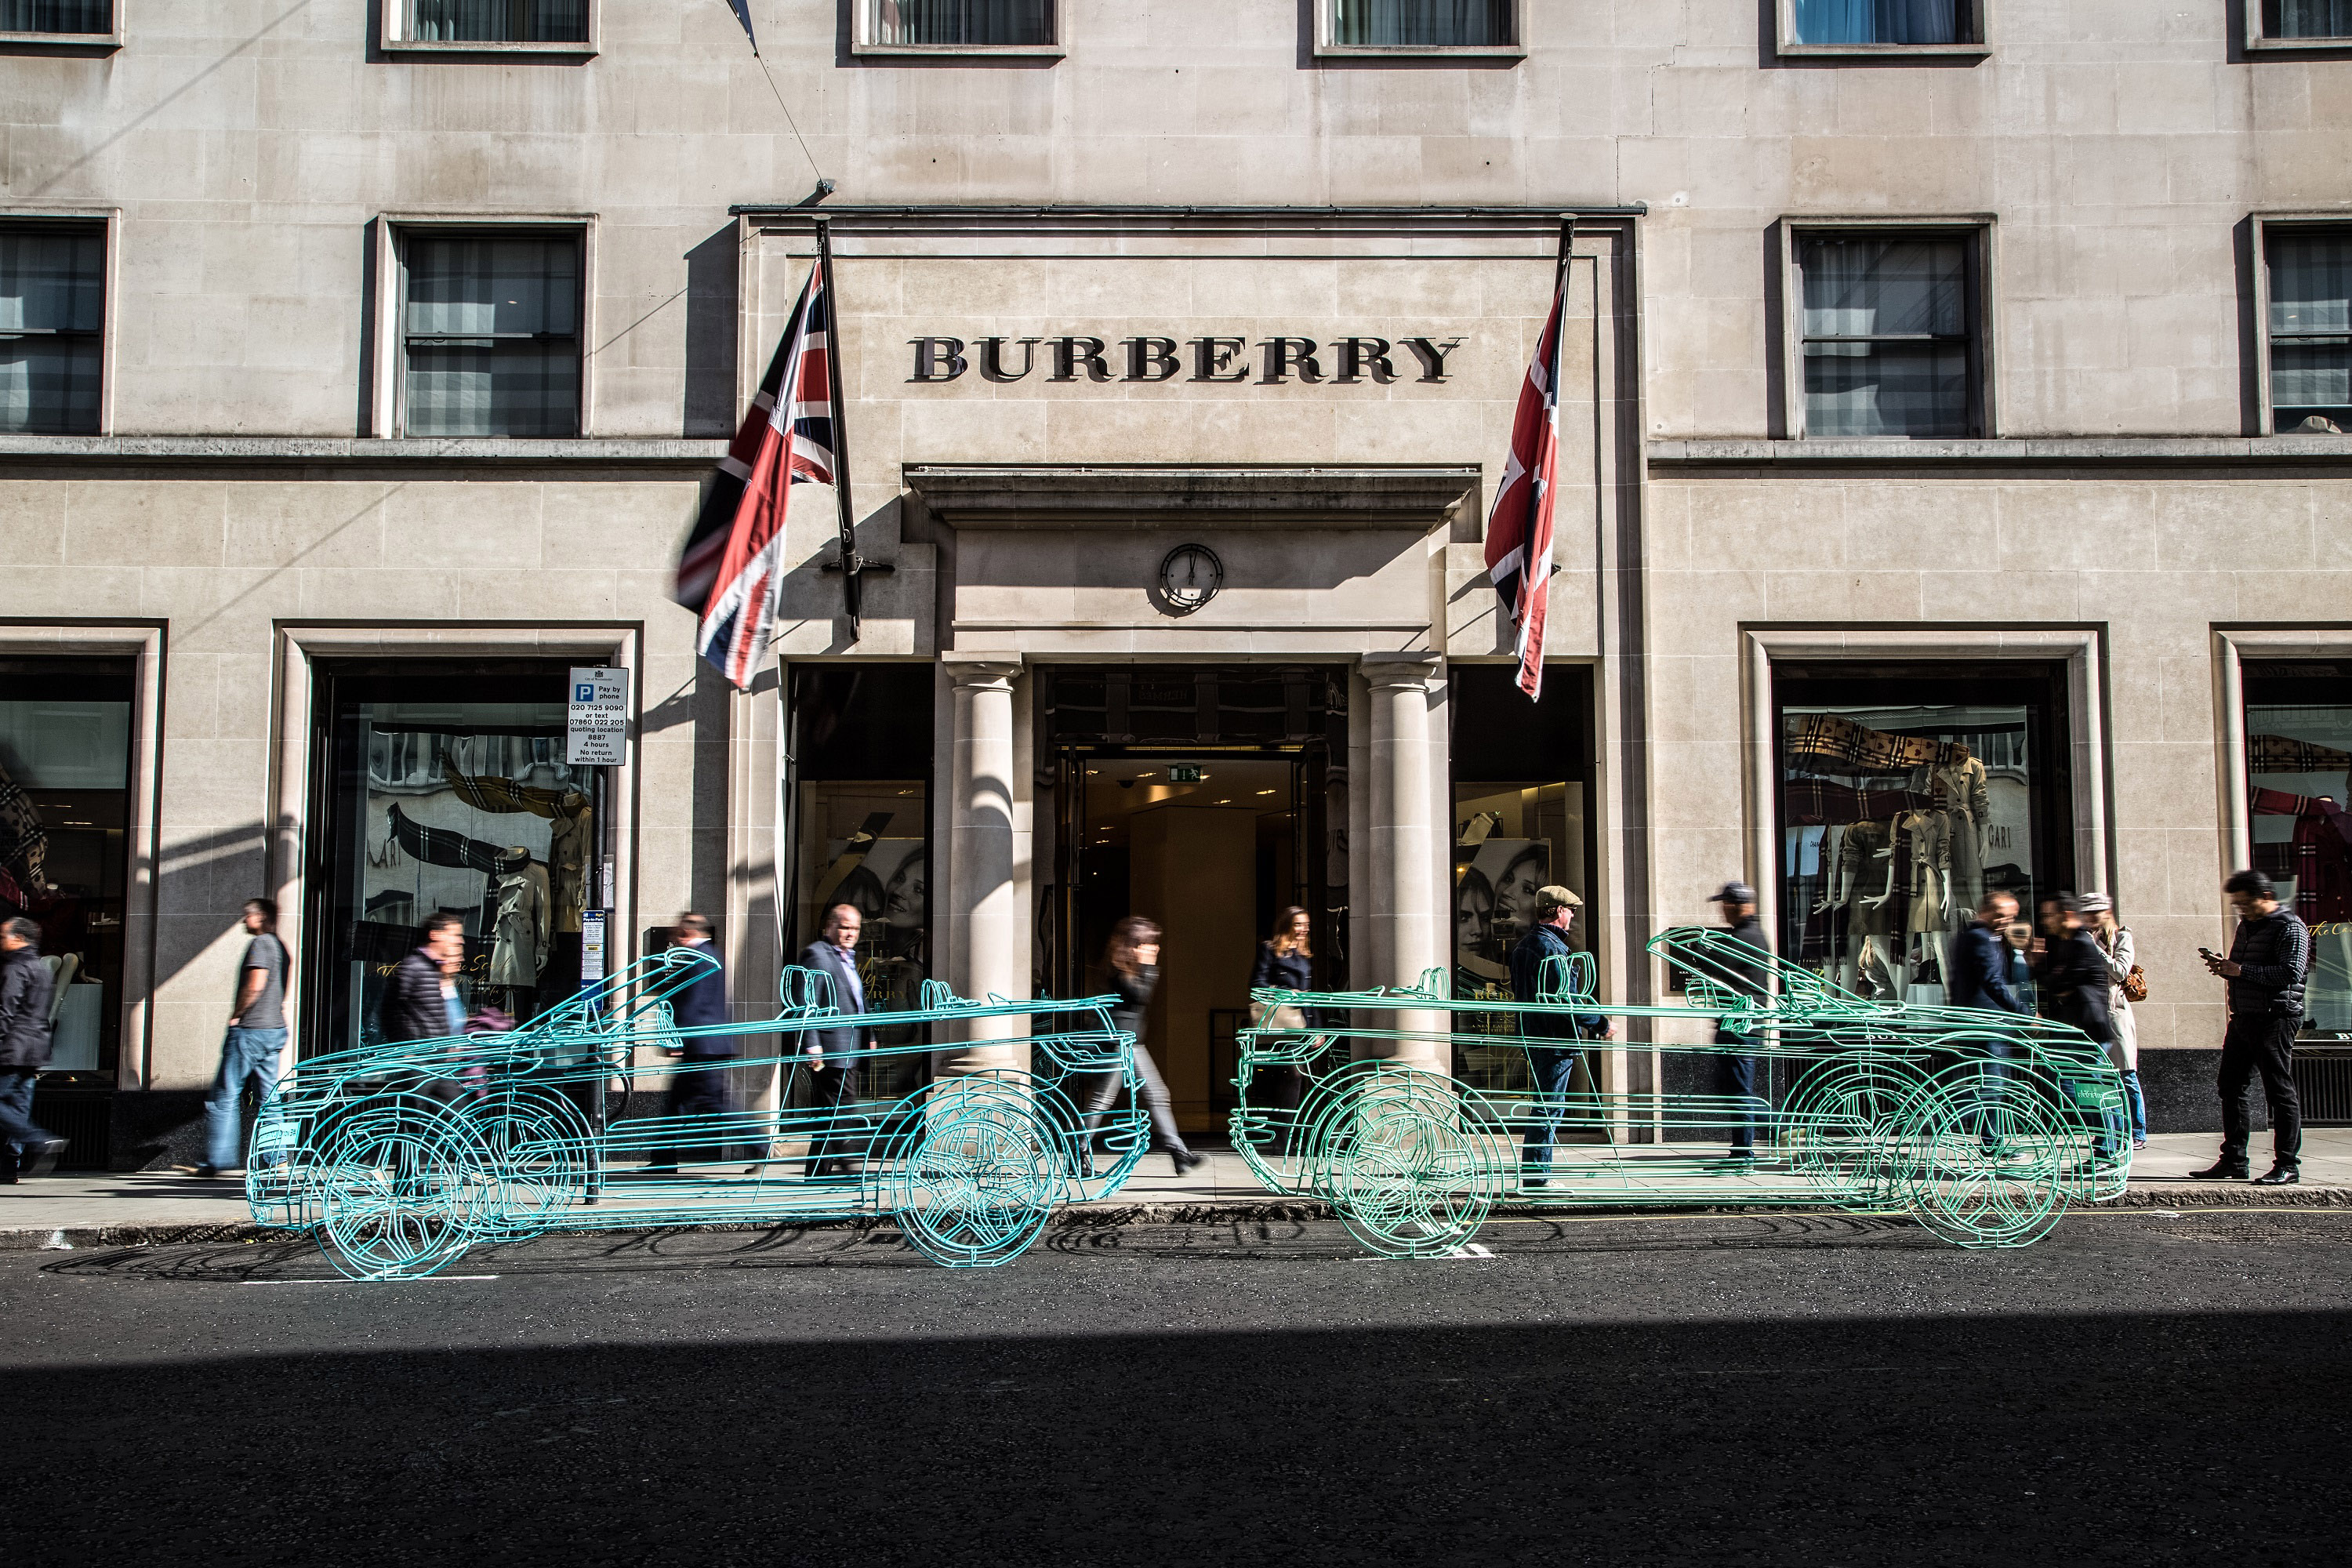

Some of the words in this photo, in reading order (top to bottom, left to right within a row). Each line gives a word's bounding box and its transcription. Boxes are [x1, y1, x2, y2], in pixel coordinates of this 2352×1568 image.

[905, 336, 1469, 383] BURBERRY
[580, 686, 591, 700] P
[1988, 824, 2011, 848] GARI
